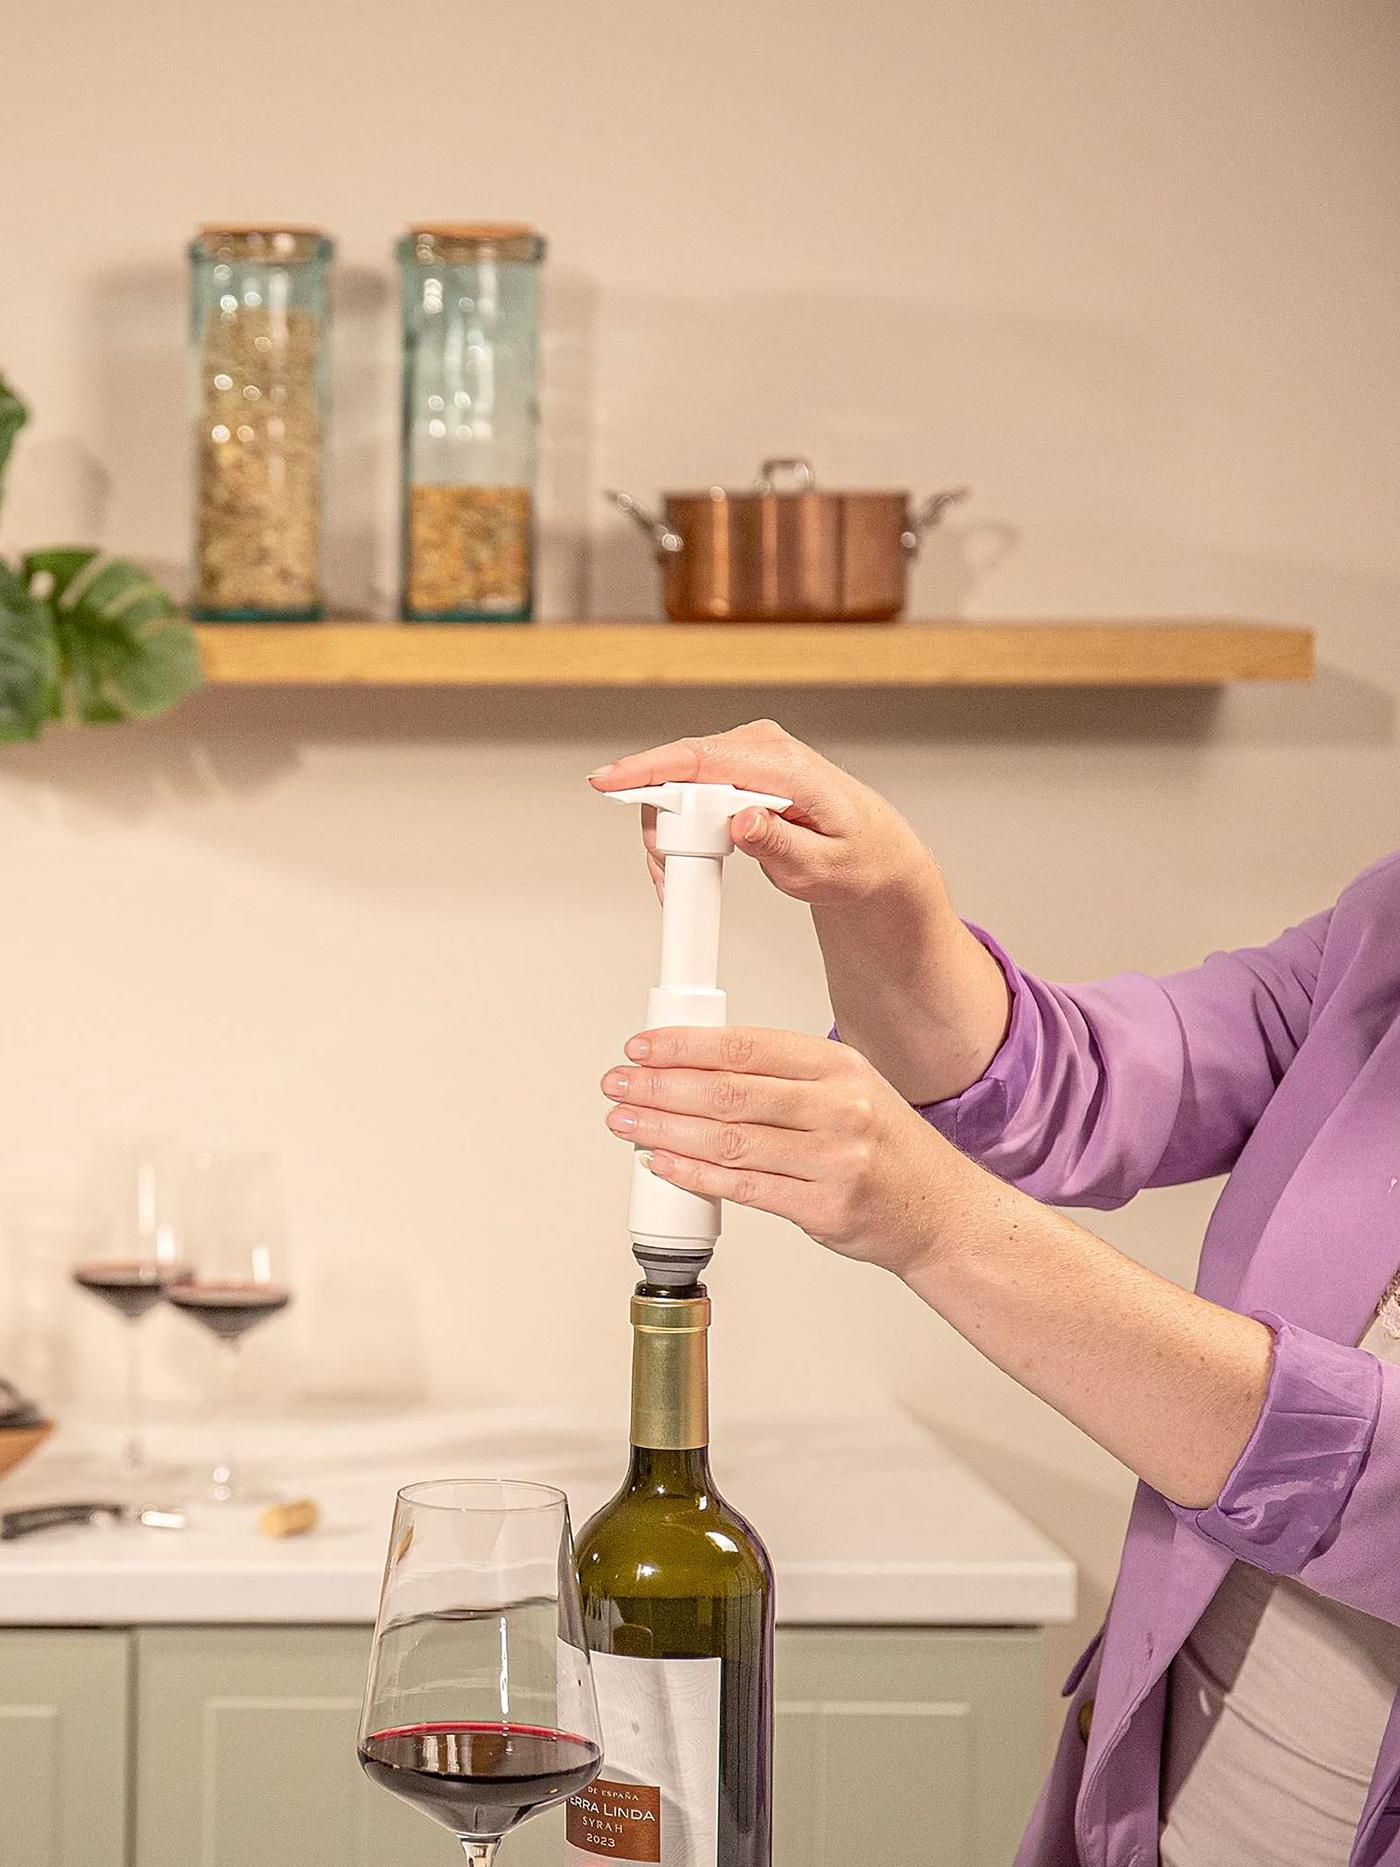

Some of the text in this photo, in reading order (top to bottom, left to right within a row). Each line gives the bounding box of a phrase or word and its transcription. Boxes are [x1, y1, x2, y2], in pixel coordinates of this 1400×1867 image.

[587, 1786, 639, 1801] DE ESPAÑA
[568, 1796, 656, 1821] ERRA LINDA
[582, 1816, 623, 1833] SYRAH
[586, 1833, 616, 1848] 2023
